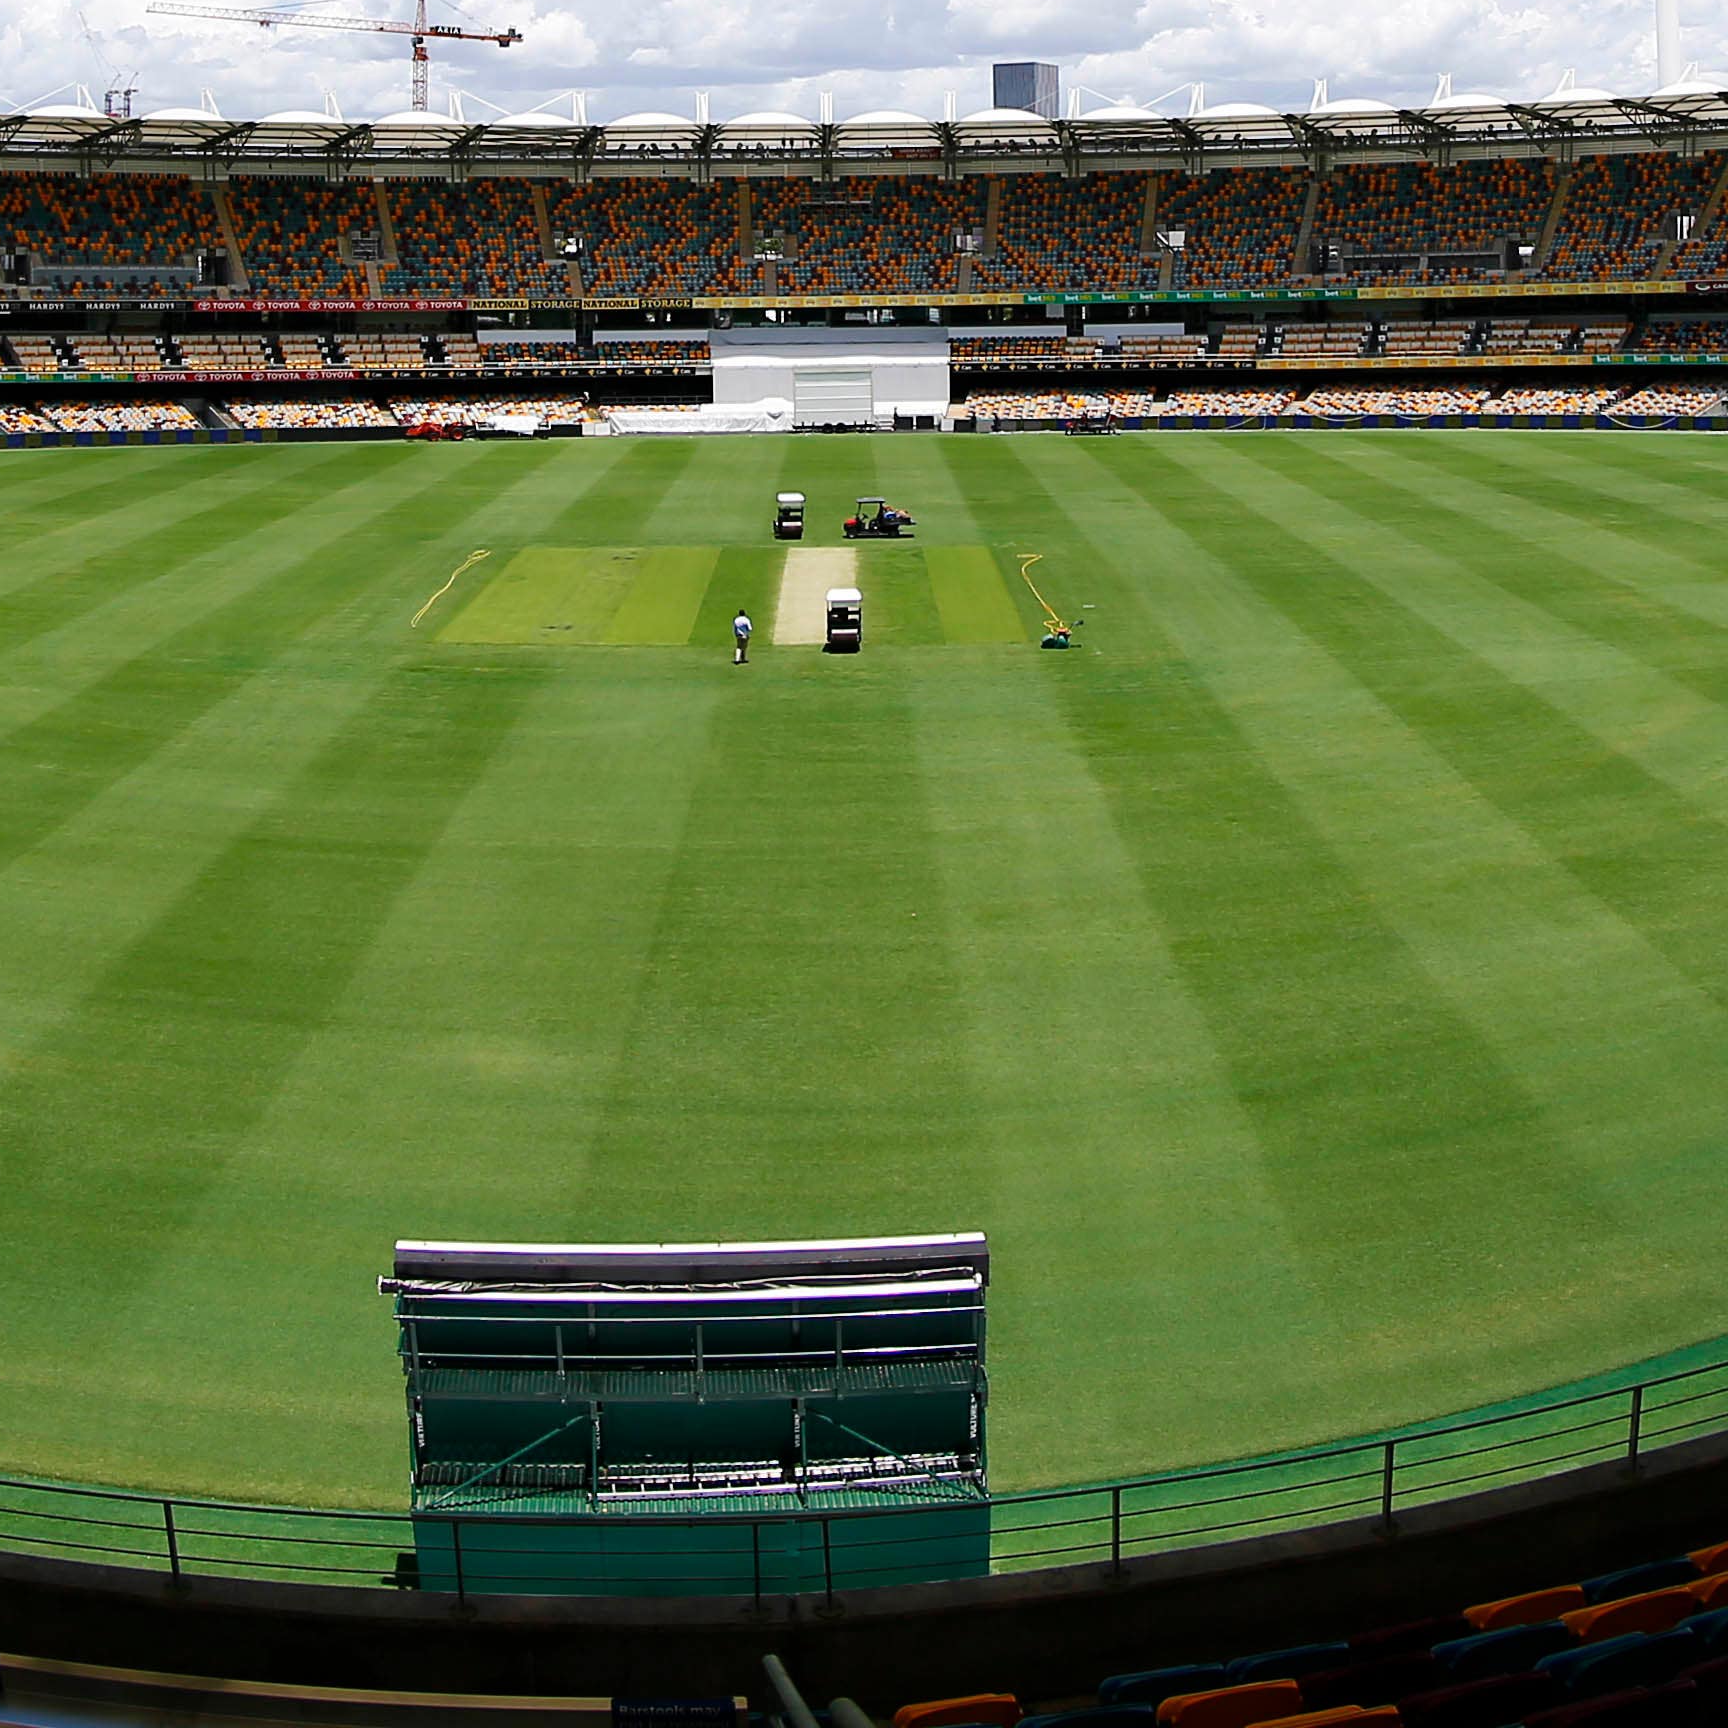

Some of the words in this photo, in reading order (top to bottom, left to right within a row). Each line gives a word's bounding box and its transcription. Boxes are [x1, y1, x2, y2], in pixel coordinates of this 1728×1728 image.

[213, 302, 245, 310] TOYOTA
[430, 301, 463, 309] TOYOTA
[473, 300, 527, 309] NATIONAL
[531, 300, 580, 308] STORAGE
[583, 300, 638, 308] NATIONAL
[641, 299, 690, 308] STORAGE
[26, 373, 53, 381] bet
[153, 373, 185, 381] TOYOTA
[209, 373, 243, 381] TOYOTA
[267, 372, 300, 380] TOYOTA
[322, 371, 354, 379] TOYOTA
